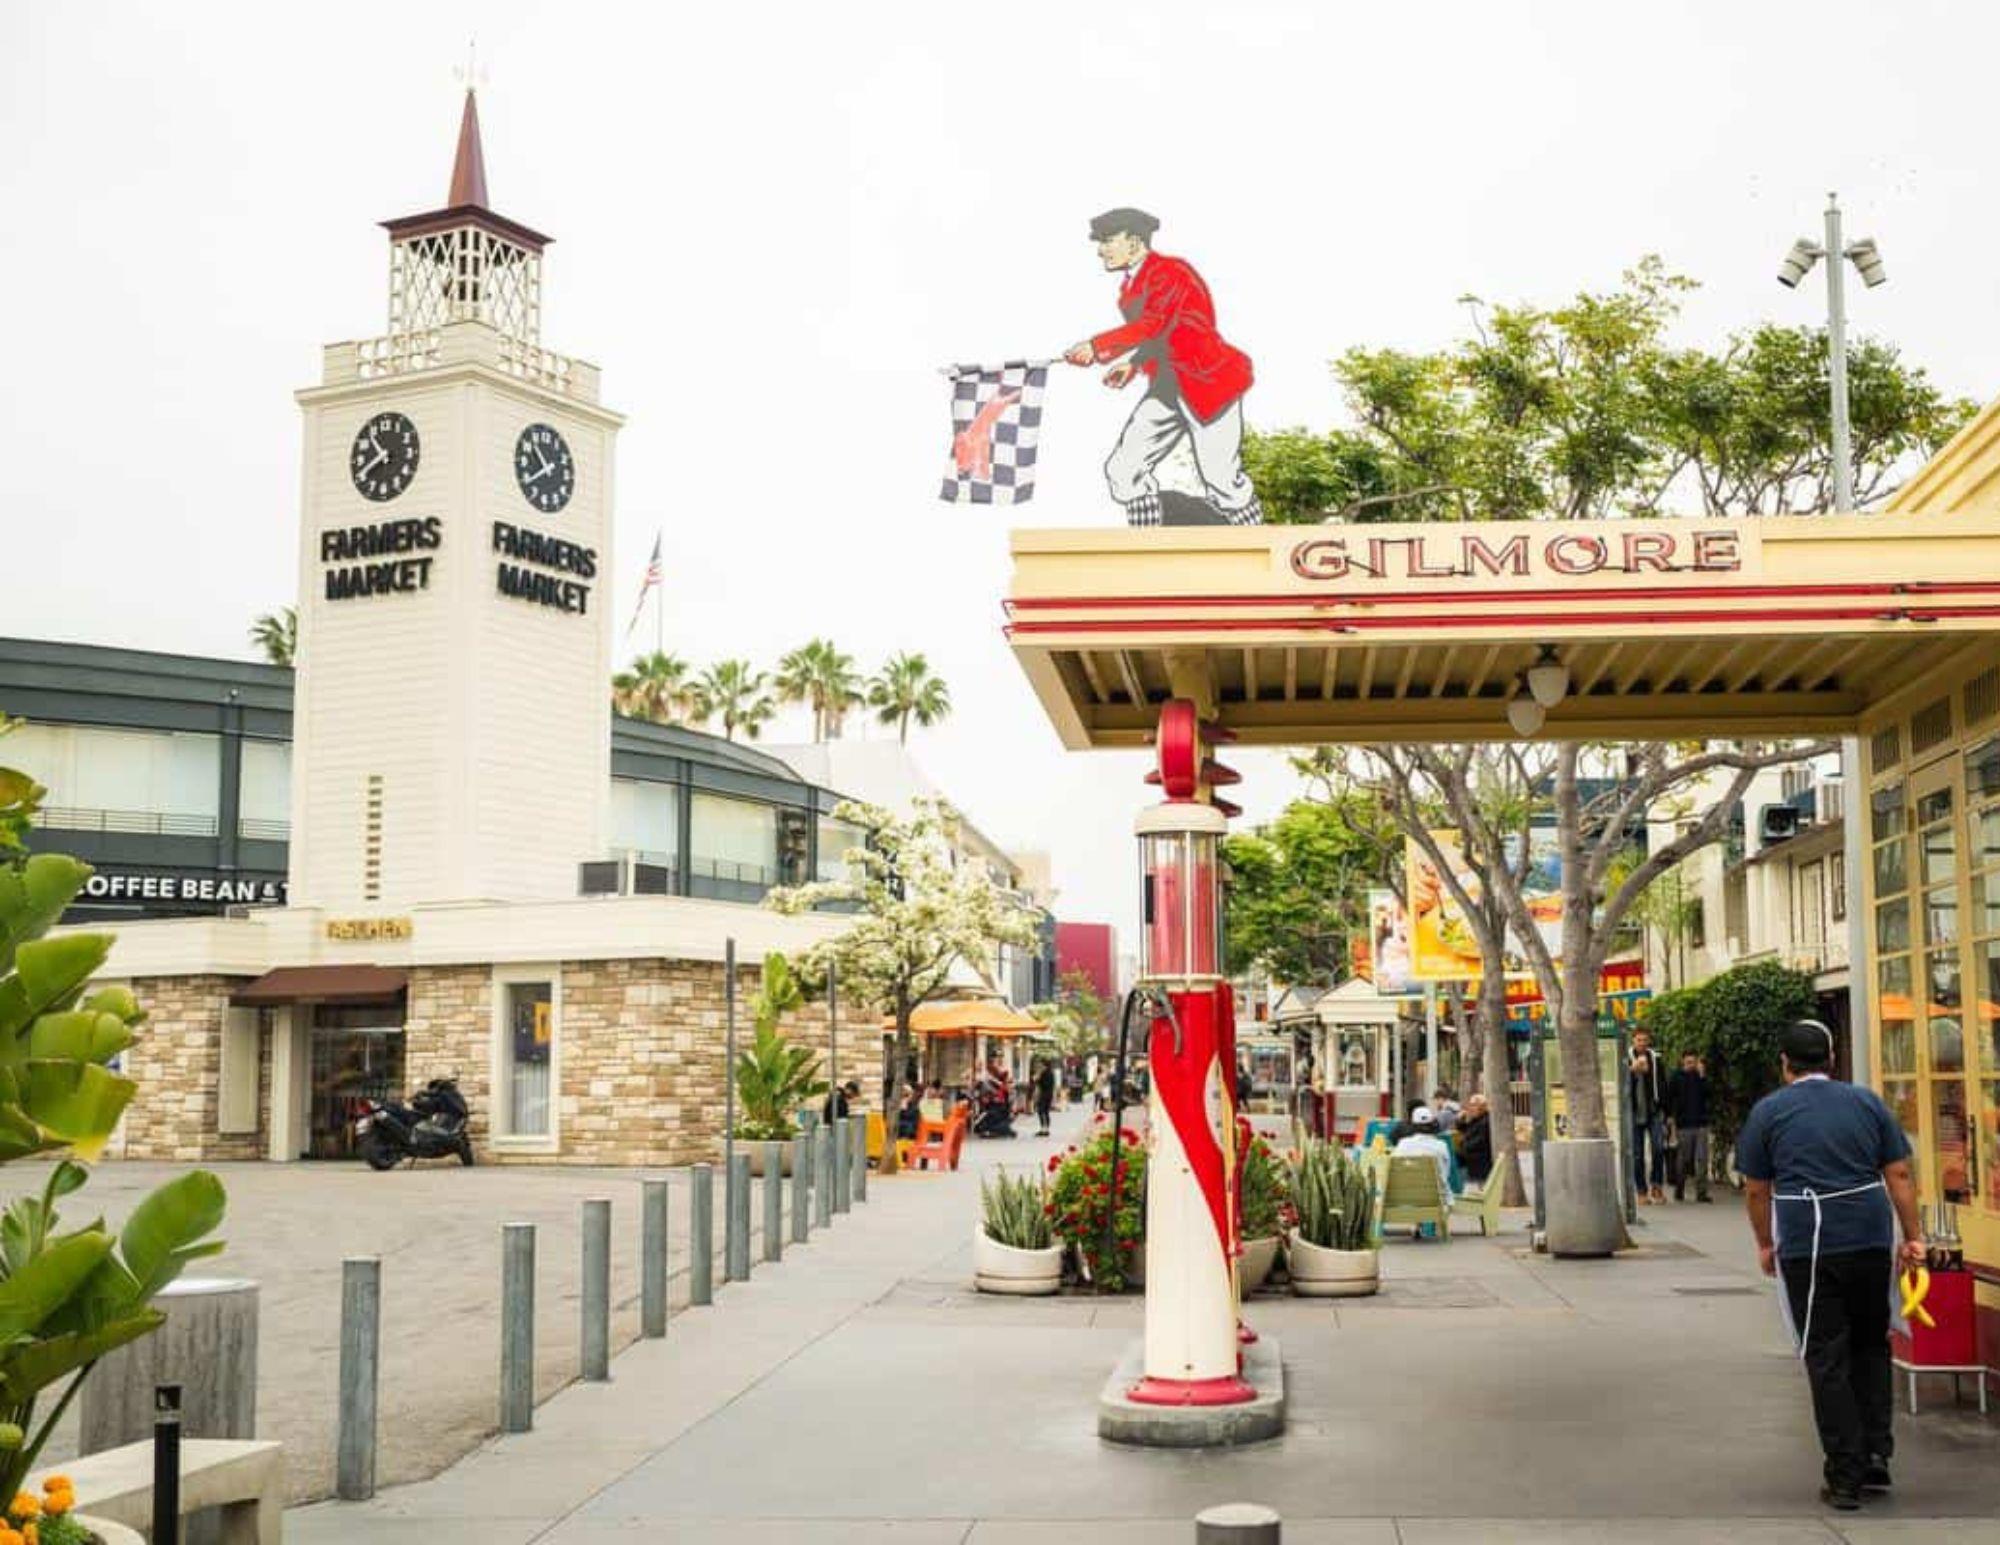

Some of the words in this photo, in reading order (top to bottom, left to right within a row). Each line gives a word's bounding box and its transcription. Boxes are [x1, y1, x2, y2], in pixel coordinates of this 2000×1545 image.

[321, 516, 442, 562] FARMERS
[493, 520, 598, 580] FARMERS
[1289, 531, 1742, 580] GILMORE
[325, 557, 434, 600] MARKET
[497, 561, 592, 614] MARKET
[78, 875, 175, 897] OFFEE
[181, 879, 255, 901] BEAN
